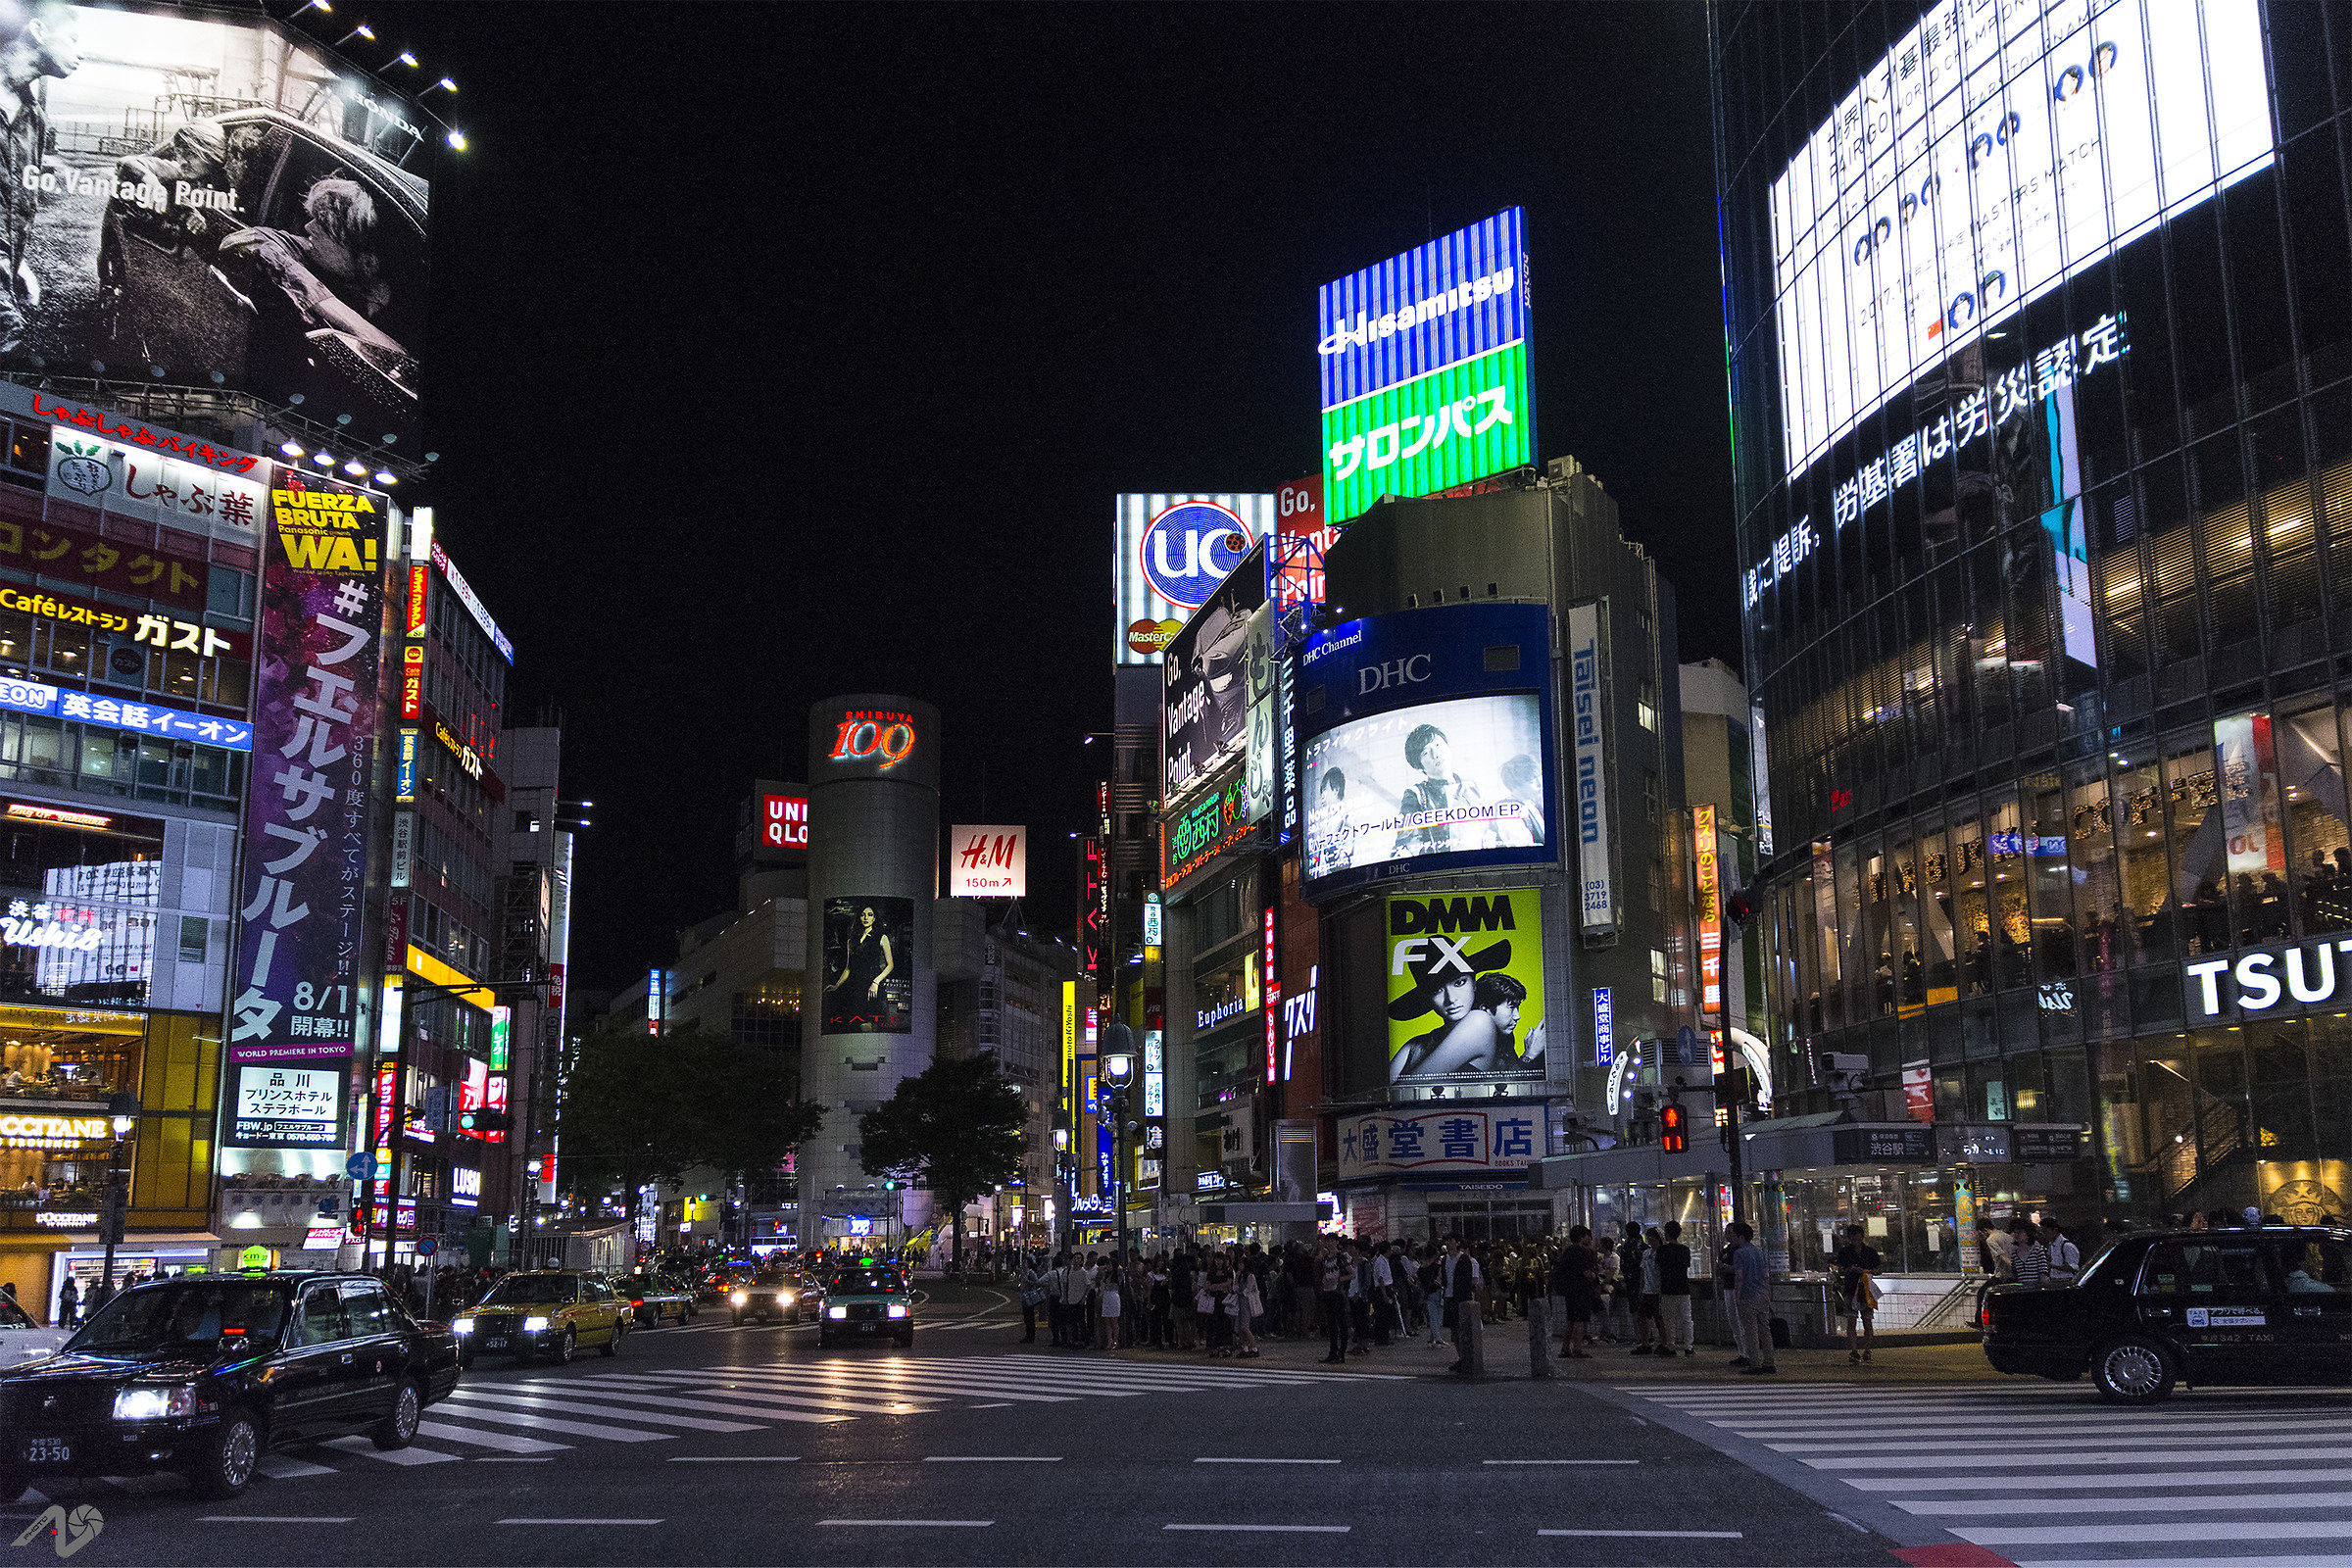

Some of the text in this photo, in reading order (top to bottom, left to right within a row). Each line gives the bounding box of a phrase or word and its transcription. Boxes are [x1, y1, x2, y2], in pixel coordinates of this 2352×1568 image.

[350, 92, 424, 142] HONDA
[62, 167, 167, 214] Vantage
[174, 180, 246, 214] Point.
[1317, 265, 1514, 355] Hisamitsu
[32, 393, 259, 473] しゃぶしゃぶバイキング
[1329, 384, 1512, 481] サロンパス
[1836, 313, 2126, 529] 労基署は労災認定
[126, 463, 255, 526] しゃぶ葉
[272, 489, 376, 514] FUERZA
[1280, 486, 1316, 517] Go,
[274, 508, 361, 530] BRUTA
[278, 524, 328, 536] Panasonic
[279, 534, 377, 571] WA!
[134, 613, 231, 658] ガスト
[1302, 630, 1362, 667] DHC Channel
[1357, 653, 1432, 696] DHC
[405, 676, 420, 713] ガスト
[63, 693, 248, 743] 英会話イーオン
[845, 710, 913, 723] SHIBUYA
[827, 719, 916, 769] 109
[1572, 639, 1600, 844] Taisei neon
[769, 801, 808, 822] UNI
[1498, 803, 1521, 817] EP
[959, 833, 1017, 870] H&M
[1388, 862, 1411, 875] DHC
[1697, 808, 1718, 924] クスリのことなら
[965, 878, 1000, 889] 150m
[1583, 891, 1608, 901] 3719
[1584, 880, 1605, 892] (03)
[1390, 894, 1517, 937] DMM
[1584, 900, 1608, 910] 2468
[1391, 936, 1475, 976] FX
[1700, 931, 1721, 1004] 三千里
[2187, 939, 2352, 1016] TSU
[293, 981, 348, 1014] 8/1
[1197, 995, 1244, 1029] Euphoria
[290, 1015, 350, 1039] 開幕!!
[1596, 992, 1612, 1064] 大盛堂商事ビル
[237, 1050, 267, 1058] WORLD
[269, 1047, 306, 1056] PREMIERE
[318, 1046, 346, 1054] TOKYO
[245, 1089, 333, 1102] プリンスホテル
[270, 1072, 312, 1089] 品川
[236, 1120, 273, 1132] FBW.jp
[250, 1102, 326, 1115] ステラボール
[1343, 1118, 1533, 1165] 大盛堂書店
[452, 1166, 481, 1197] LUSH
[28, 1446, 71, 1462] 23-50
